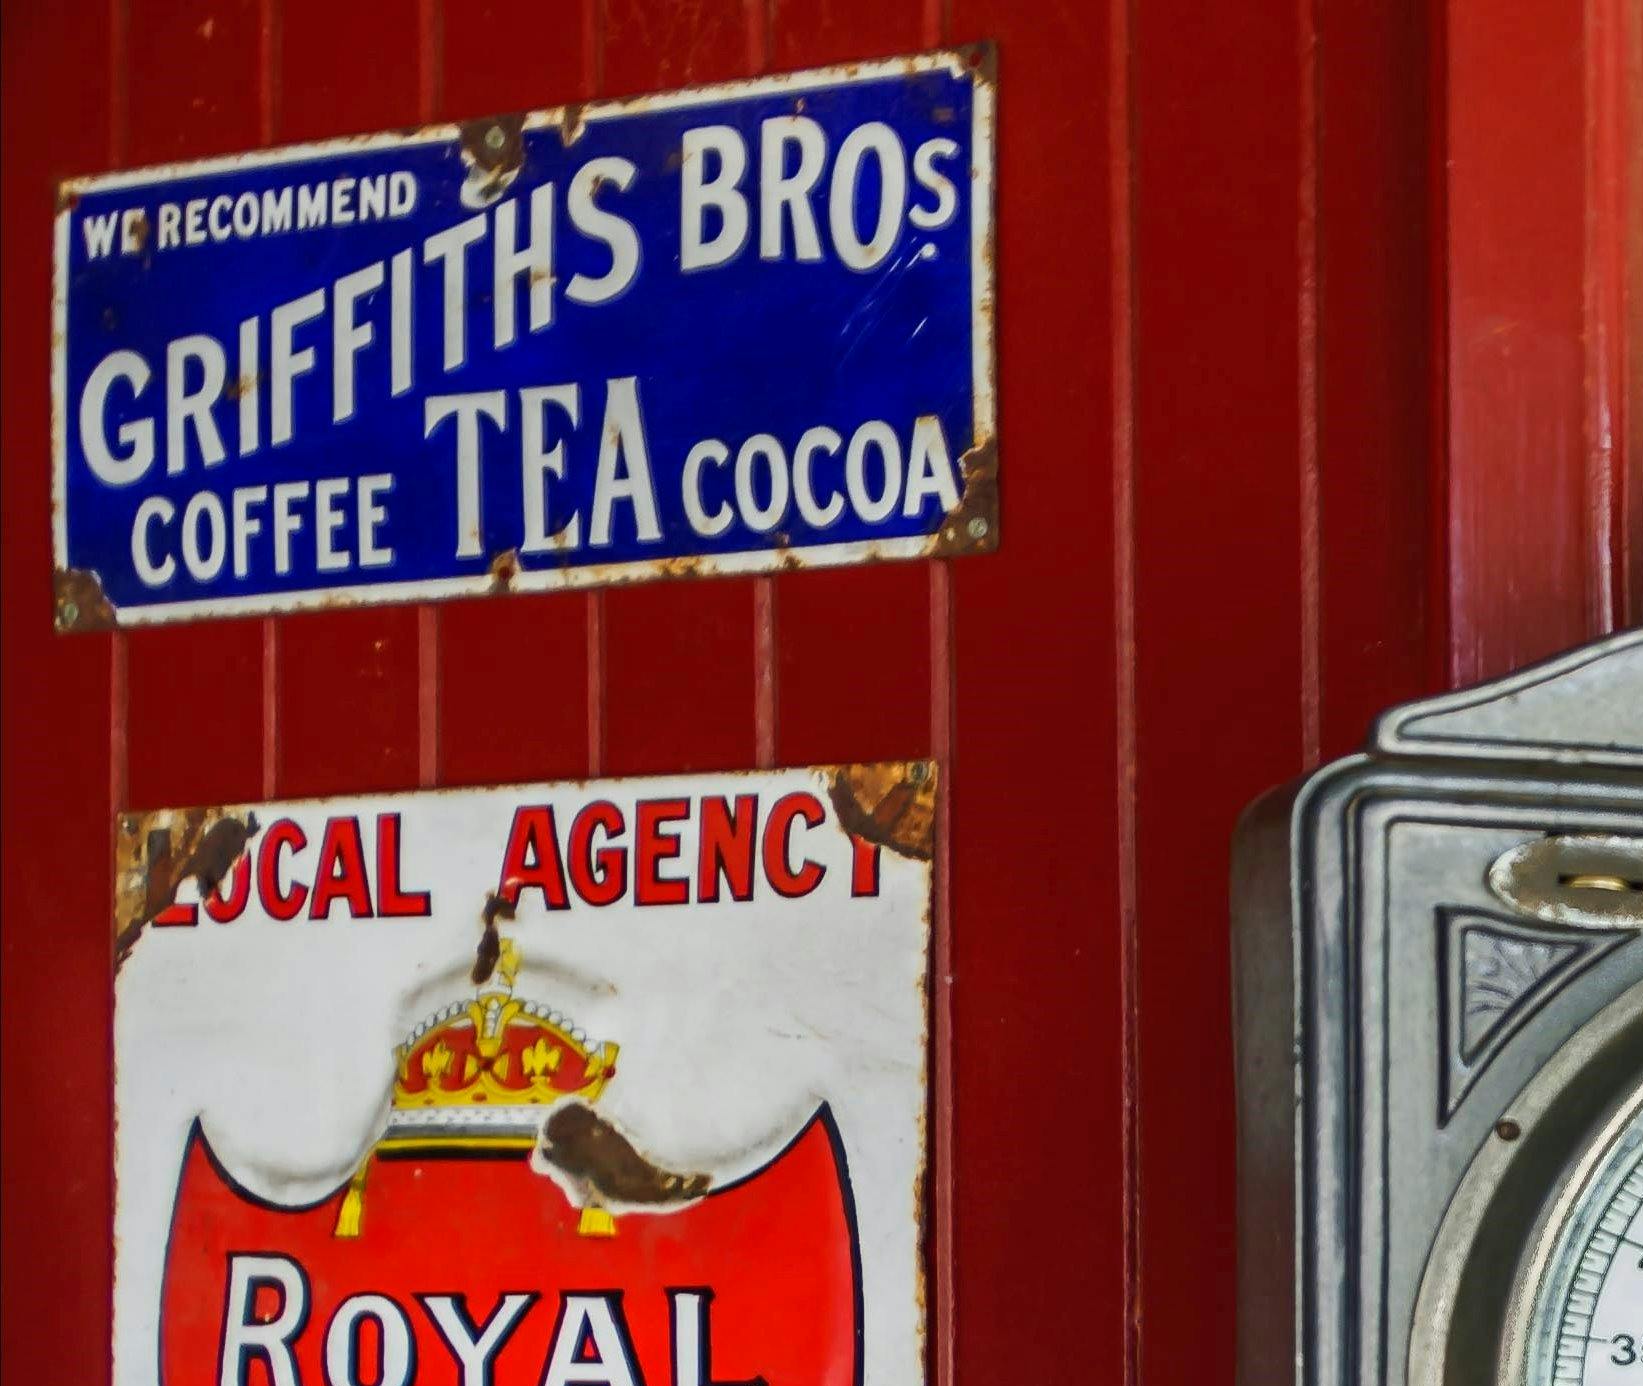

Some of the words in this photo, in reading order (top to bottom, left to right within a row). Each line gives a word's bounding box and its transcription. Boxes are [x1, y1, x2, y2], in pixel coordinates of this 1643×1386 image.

[158, 170, 419, 247] RECOMMEND
[79, 156, 643, 488] GRIFFITHS
[130, 472, 395, 589] COFFEE
[424, 375, 662, 559] TEA
[681, 415, 959, 538] COCOA
